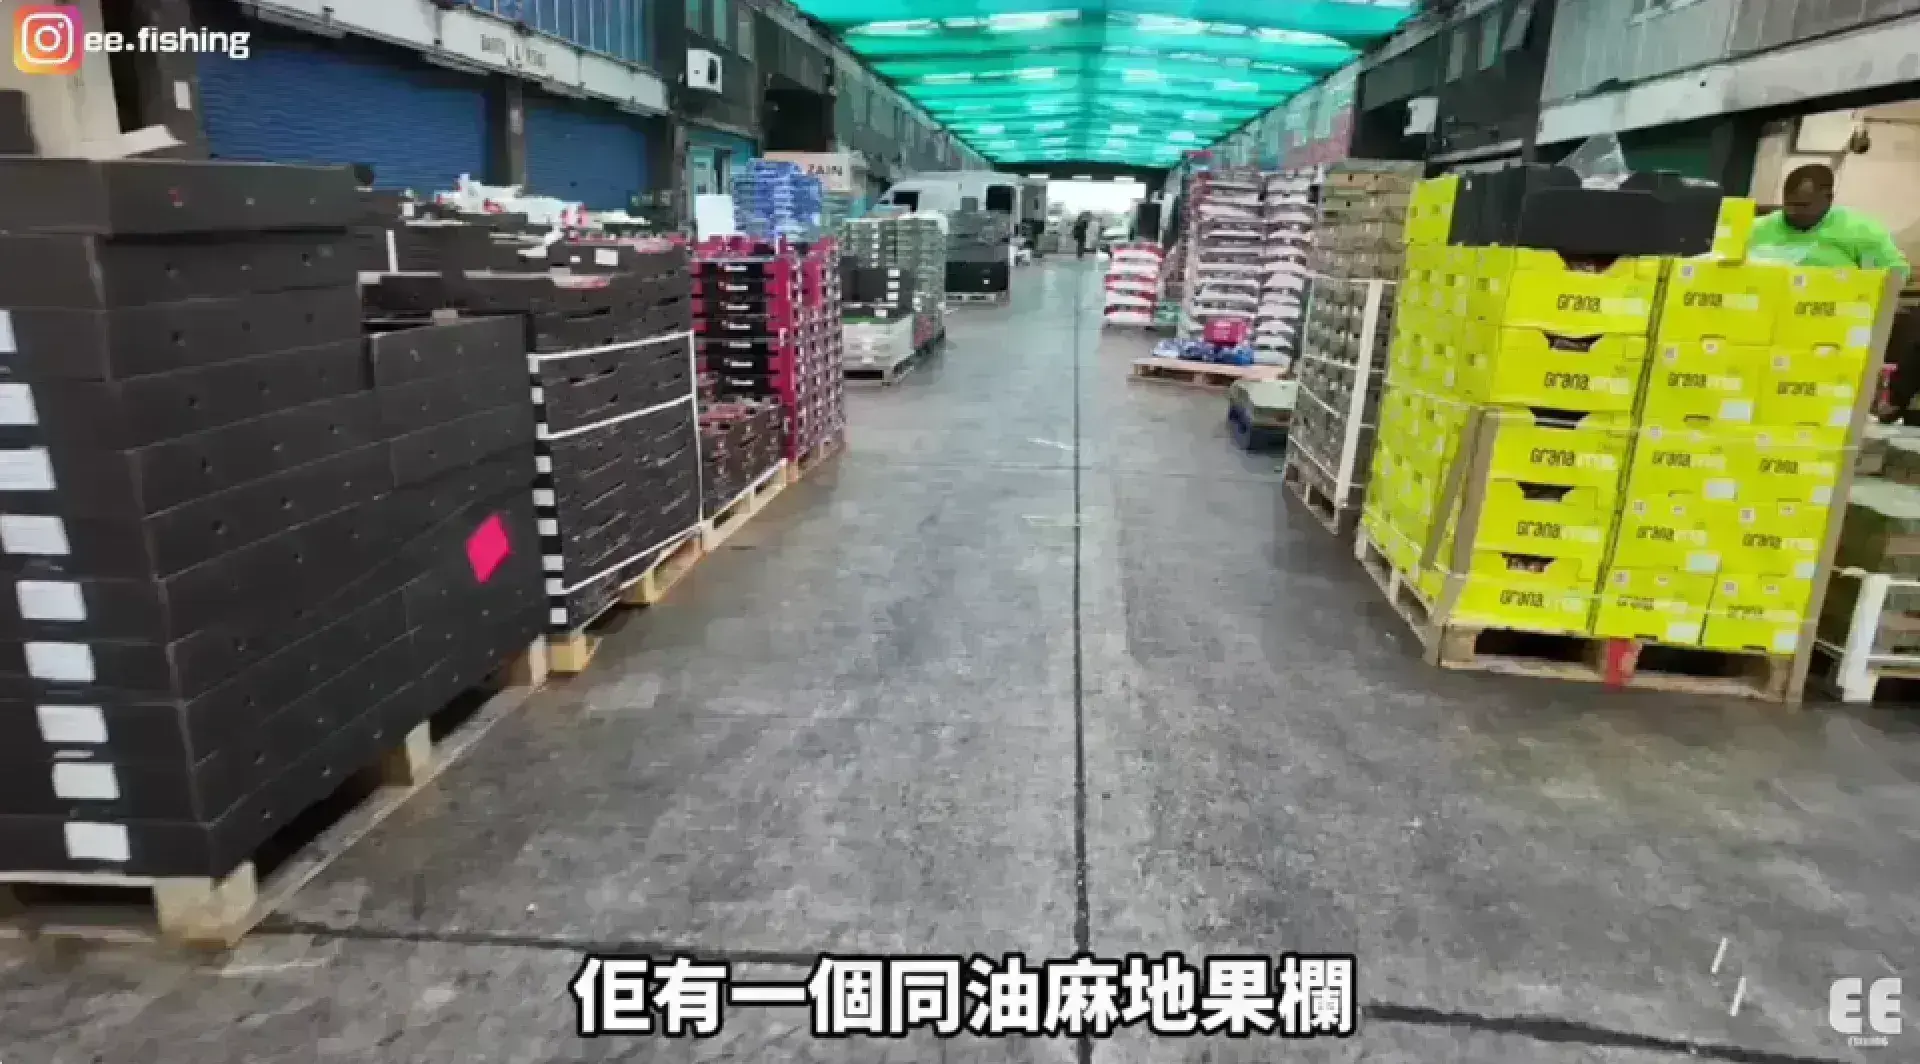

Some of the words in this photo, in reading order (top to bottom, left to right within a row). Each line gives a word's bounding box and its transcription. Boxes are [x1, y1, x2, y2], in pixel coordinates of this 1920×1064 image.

[1557, 294, 1601, 312] Grana
[1544, 372, 1590, 390] Grana
[1530, 448, 1575, 466] Grana
[1516, 520, 1562, 538] Grana
